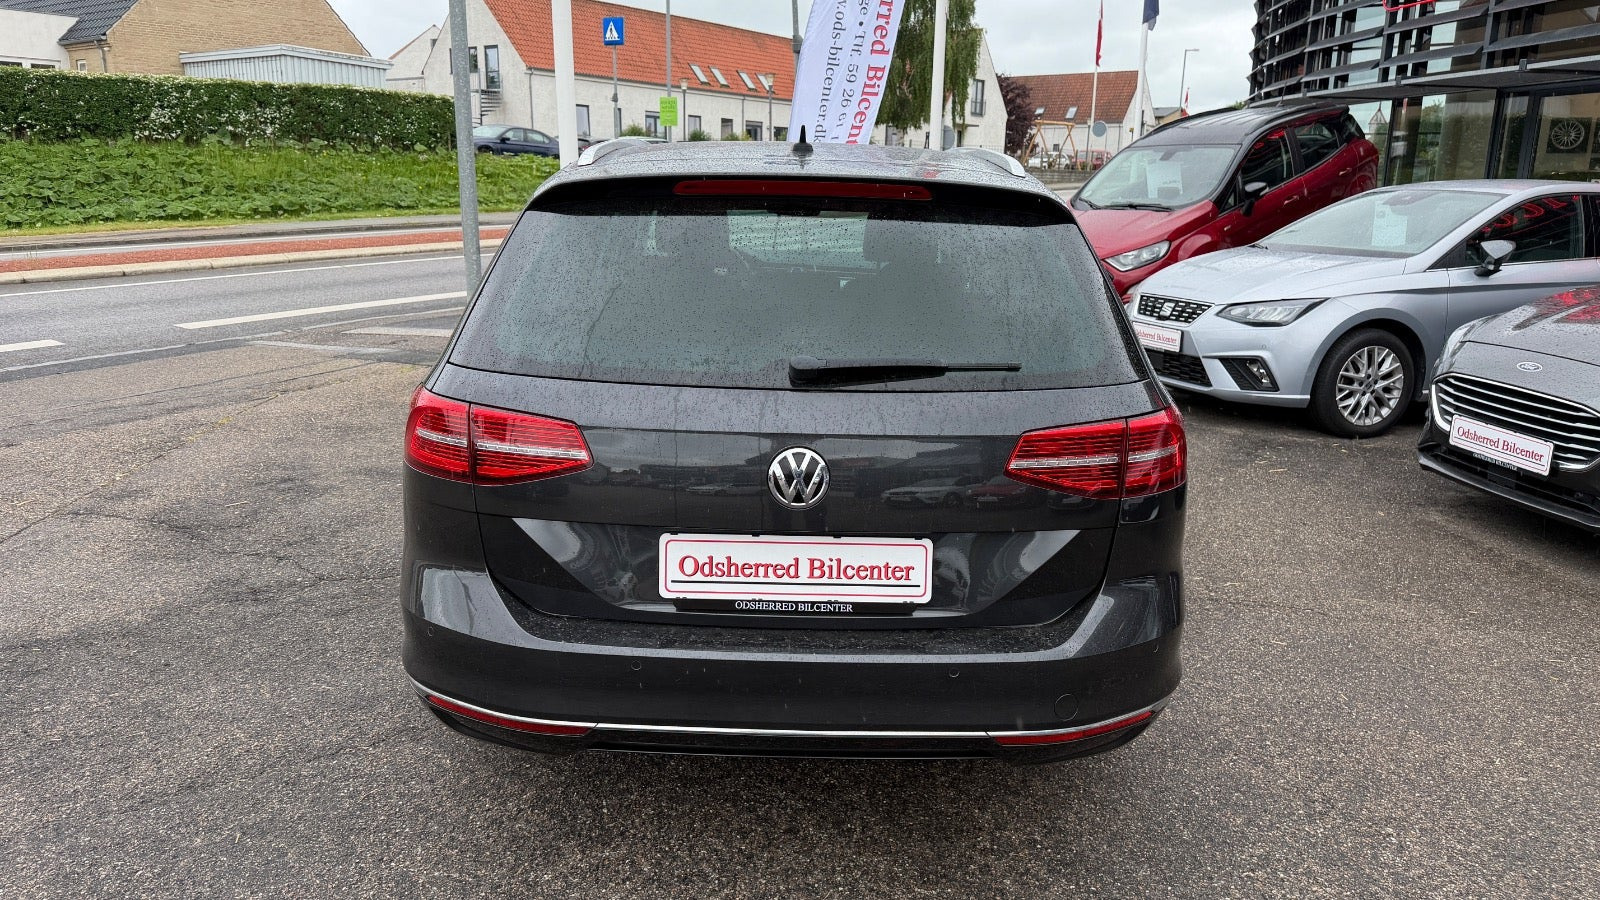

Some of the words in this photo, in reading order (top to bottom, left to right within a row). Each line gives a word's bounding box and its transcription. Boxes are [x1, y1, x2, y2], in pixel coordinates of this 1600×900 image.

[850, 31, 866, 57] Tlf.
[845, 63, 859, 83] 59
[841, 88, 855, 107] 26
[1457, 426, 1500, 449] Odsherred
[1502, 440, 1544, 462] Bilcenter
[678, 555, 800, 578] Odsherred
[807, 558, 914, 581] Bilcenter
[735, 600, 796, 611] ODSHERRED
[798, 603, 853, 612] BILCENTER
